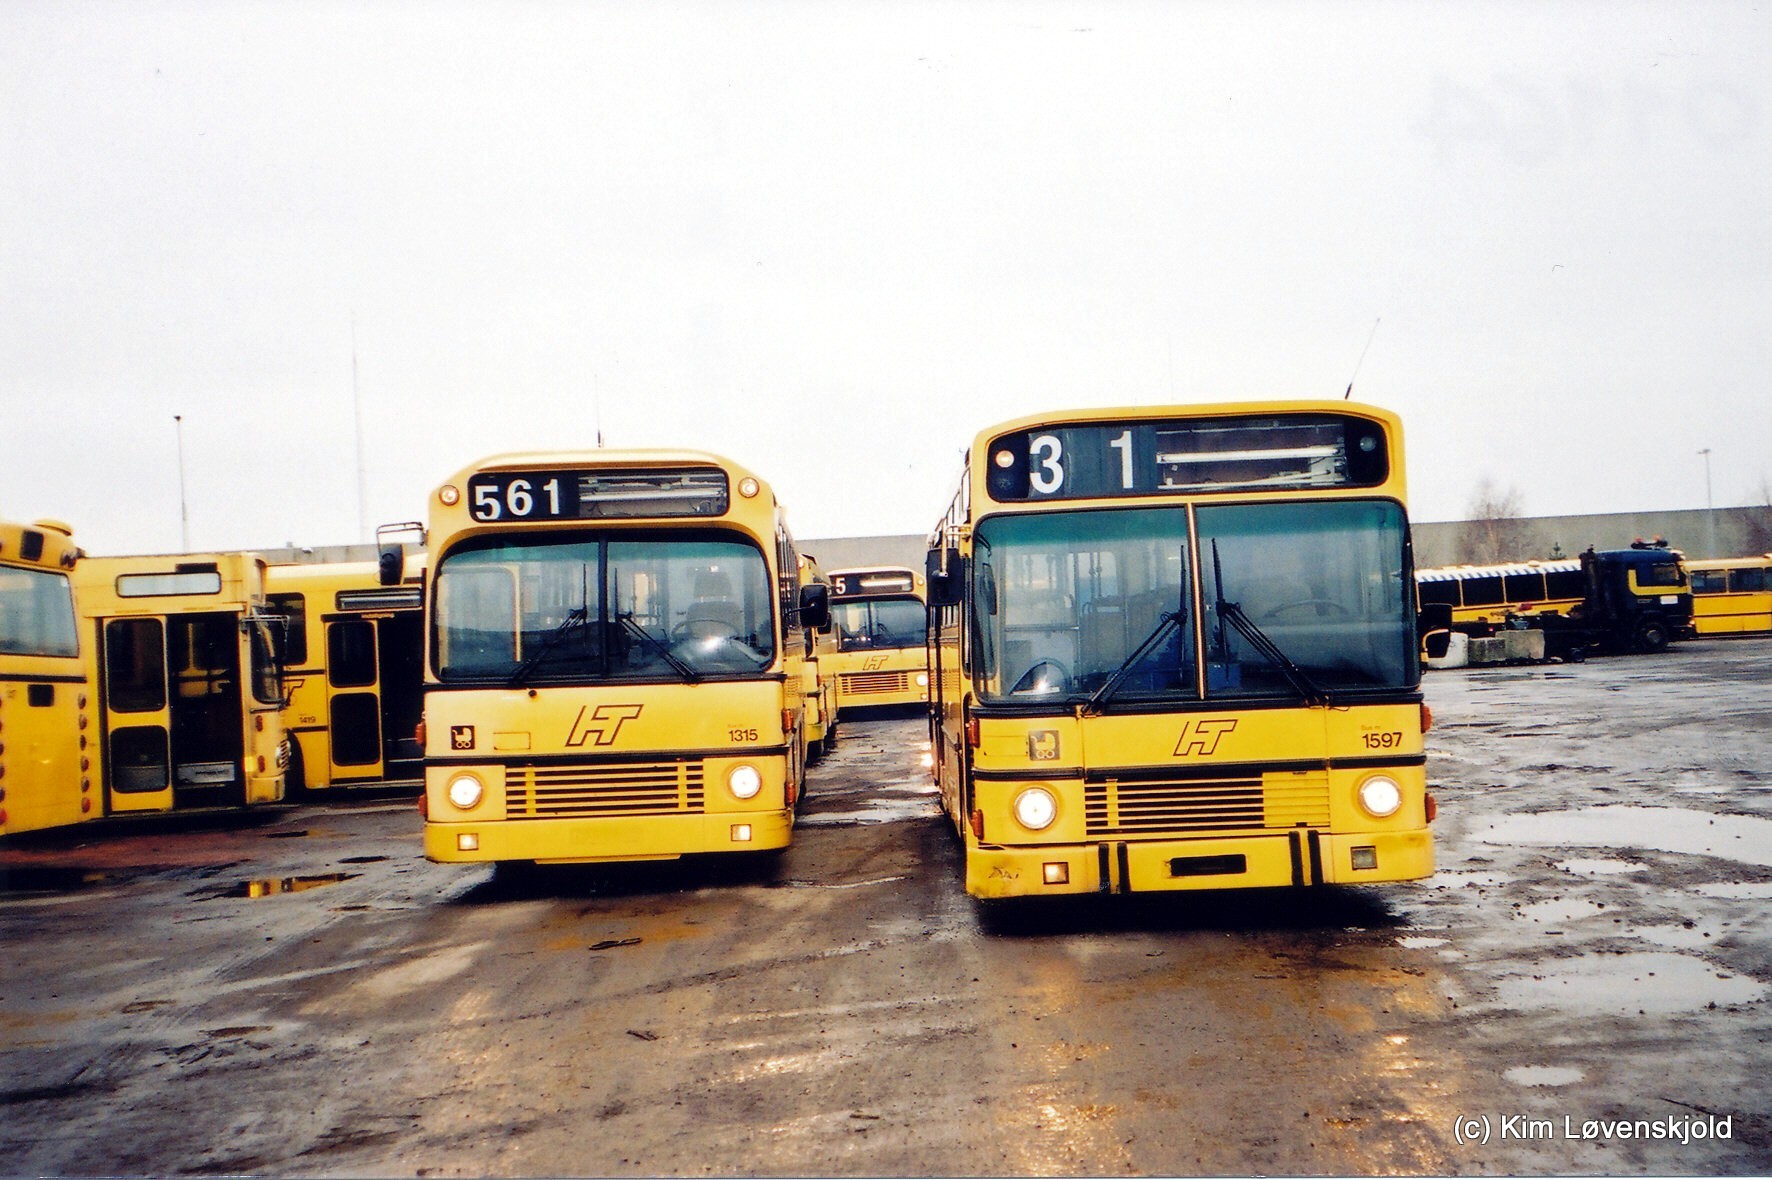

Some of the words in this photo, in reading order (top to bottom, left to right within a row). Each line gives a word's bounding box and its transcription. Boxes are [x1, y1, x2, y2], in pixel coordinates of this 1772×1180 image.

[1029, 434, 1064, 494] 3
[1110, 430, 1133, 489] 1
[474, 478, 560, 520] 561
[835, 577, 846, 595] 5
[565, 704, 644, 747] HT
[728, 728, 758, 742] 1315
[1173, 719, 1238, 756] HT
[1362, 731, 1403, 749] 1597
